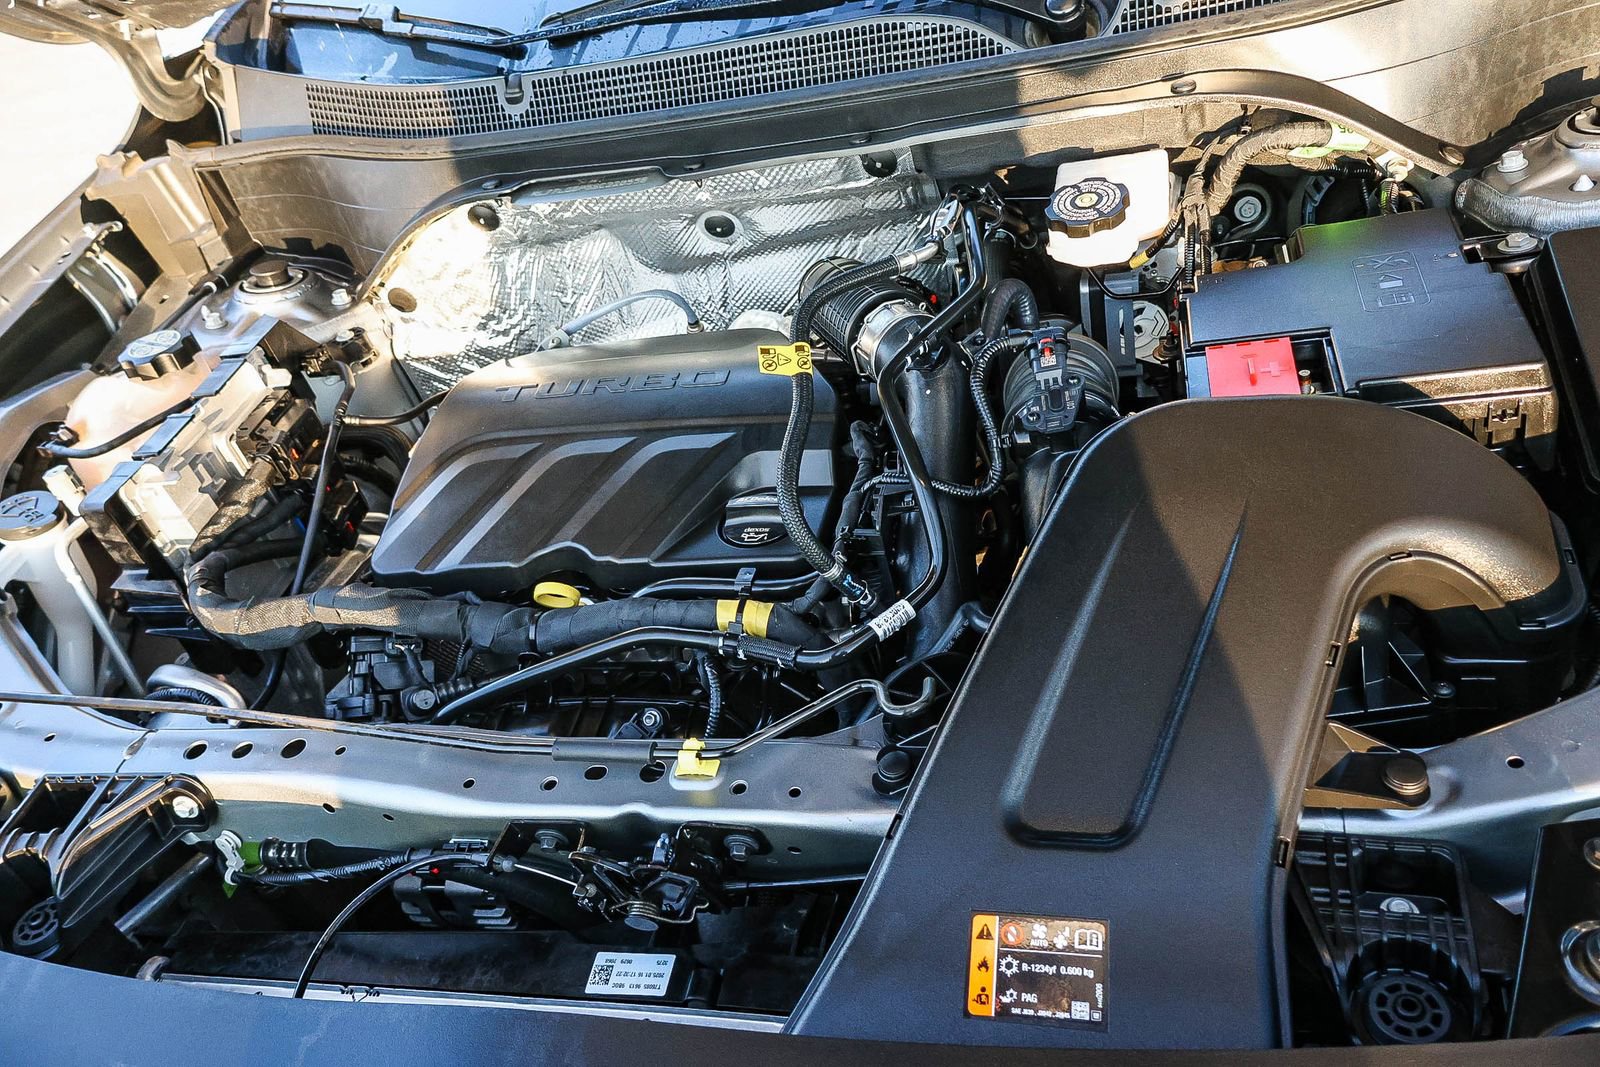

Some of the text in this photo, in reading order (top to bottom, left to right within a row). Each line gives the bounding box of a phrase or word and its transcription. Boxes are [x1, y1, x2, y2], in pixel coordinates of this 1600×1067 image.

[495, 369, 731, 402] TURBO
[1030, 939, 1049, 947] AUTO
[1021, 962, 1057, 975] R-1234yf
[1021, 993, 1038, 1003] PAG
